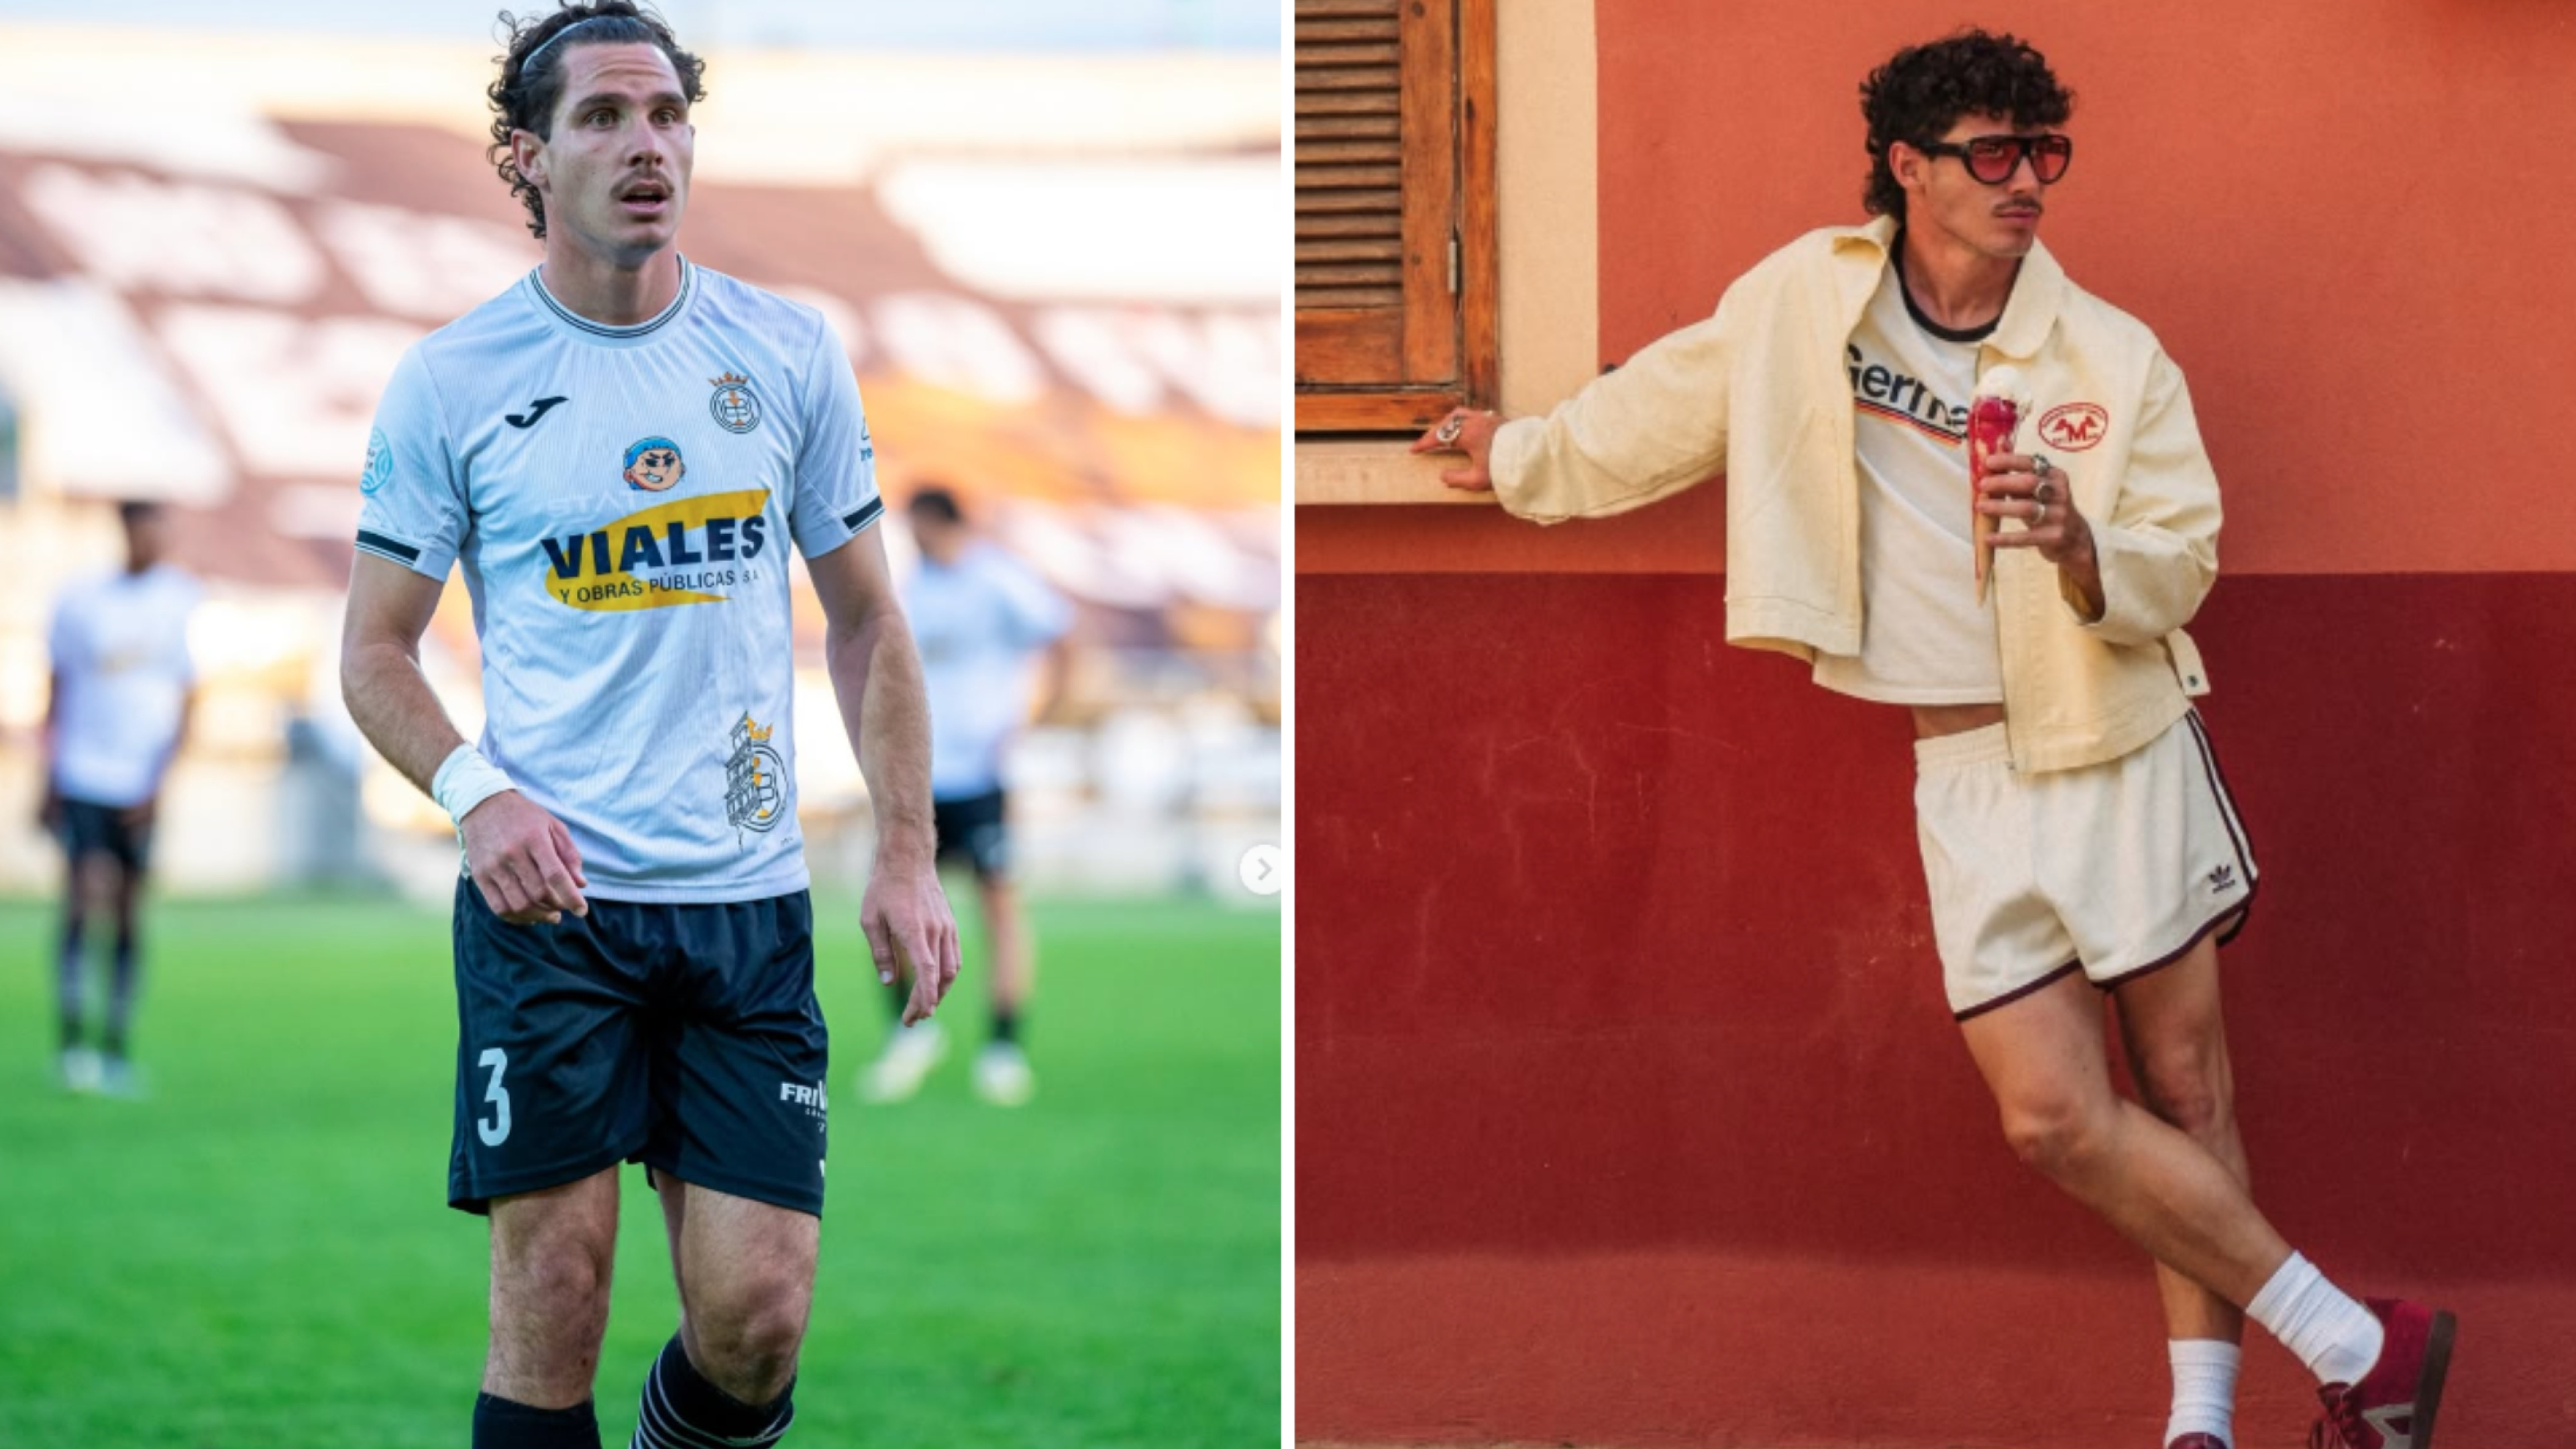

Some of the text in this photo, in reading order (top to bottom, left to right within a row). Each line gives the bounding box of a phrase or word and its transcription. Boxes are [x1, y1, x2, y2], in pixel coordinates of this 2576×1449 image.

[540, 515, 765, 580] VIALES
[559, 589, 570, 604] Y
[577, 582, 643, 603] OBRAS
[478, 1047, 511, 1146] 3
